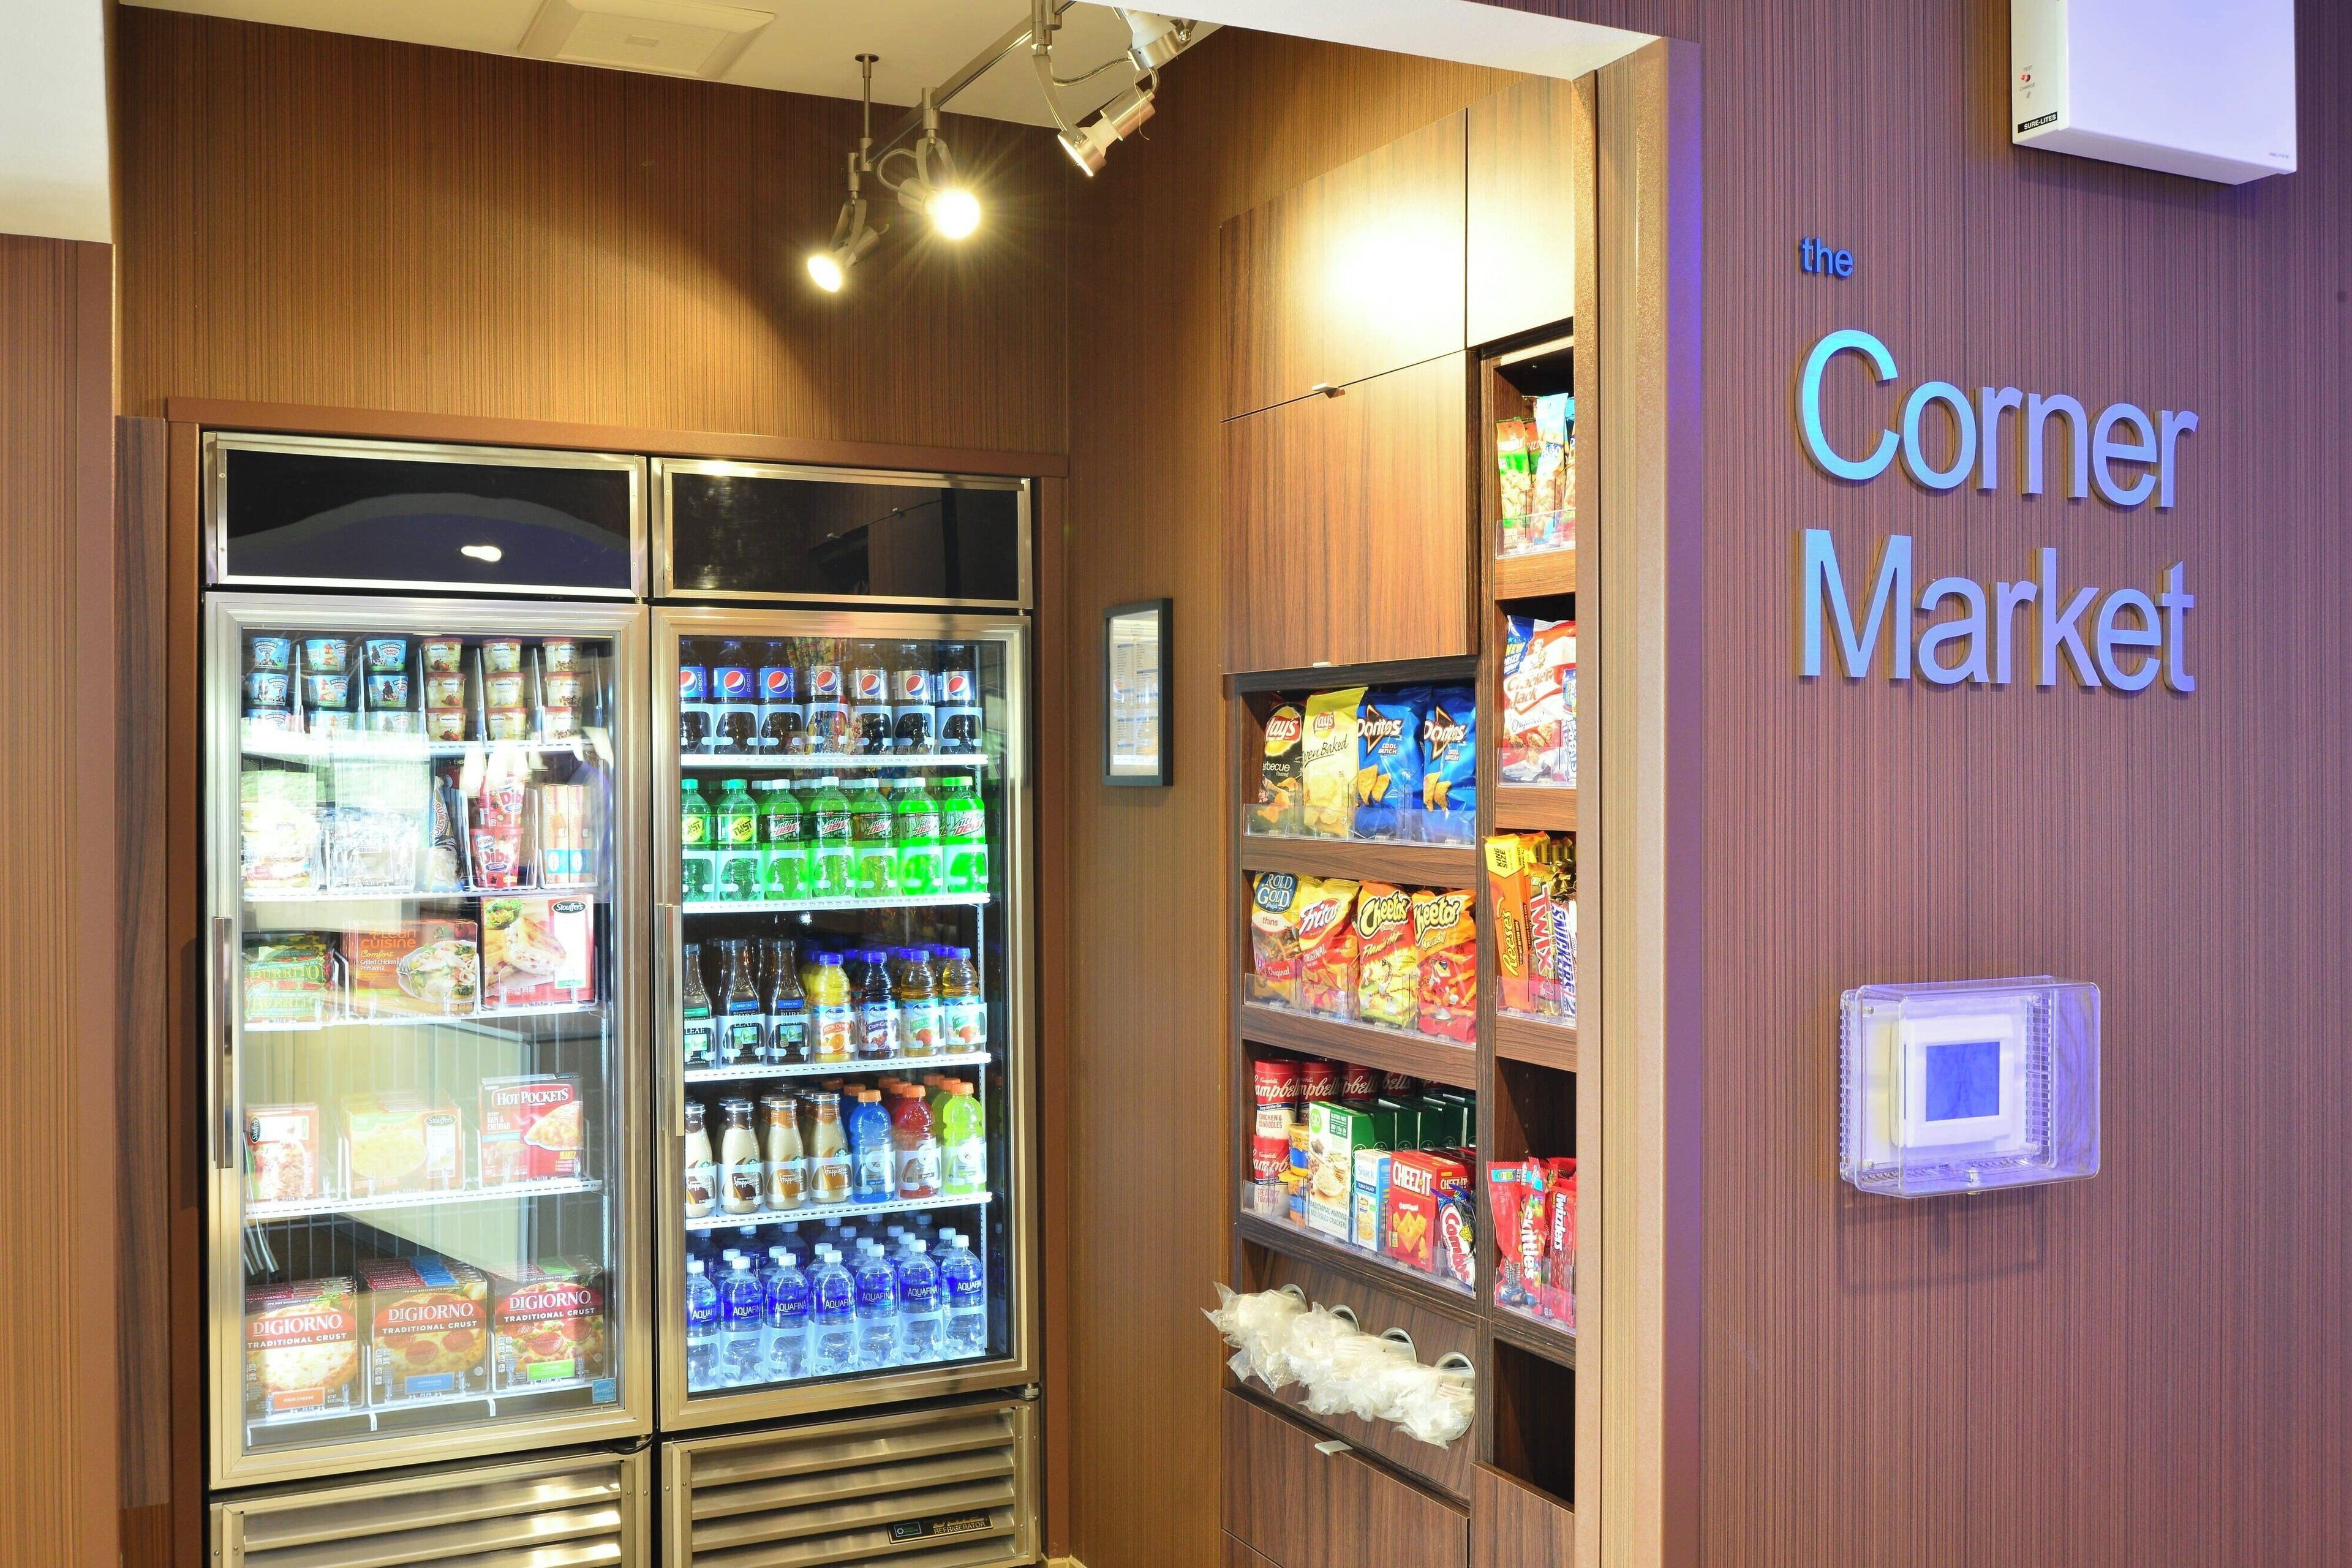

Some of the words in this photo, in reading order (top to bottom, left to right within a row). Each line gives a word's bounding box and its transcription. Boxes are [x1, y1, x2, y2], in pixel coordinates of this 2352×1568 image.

[2019, 82, 2035, 92] CHARGE
[2024, 113, 2057, 130] SURE-LITES
[1800, 237, 1854, 278] the
[1795, 328, 2199, 510] Corner
[1798, 528, 2197, 694] Market
[1510, 688, 1537, 710] Jack
[1314, 712, 1335, 729] Lay's
[1357, 718, 1403, 737] Doritos
[1266, 717, 1298, 742] Lay's
[1424, 721, 1468, 742] Doritos
[1321, 734, 1350, 756] Baked
[1262, 761, 1290, 772] arbecue
[431, 799, 447, 839] DRUMSTIC
[1494, 848, 1502, 867] KING
[1265, 873, 1291, 888] ROLD
[1257, 887, 1290, 907] GOLD
[556, 902, 584, 913] Stouffer's
[1359, 890, 1411, 939] Cheetos
[1262, 916, 1278, 927] thins
[1300, 900, 1341, 936] Fritos
[1414, 896, 1461, 945] heetos
[381, 929, 417, 939] Lean
[1530, 883, 1553, 974] TWIX
[361, 938, 417, 949] cuisine
[1502, 908, 1519, 977] Reese's
[360, 949, 394, 958] Comfort
[1303, 944, 1327, 962] ORIGINAL
[1268, 966, 1290, 979] Original
[868, 1021, 888, 1031] Cran-Gra
[497, 1091, 519, 1106] HOT
[520, 1087, 569, 1104] POCKETS
[1358, 1165, 1374, 1180] Snack
[1392, 1160, 1433, 1197] CHEEZ-IT
[1555, 1192, 1568, 1252] Twizzlers
[1444, 1212, 1471, 1283] Combos
[907, 1285, 938, 1298] AQUAFINA
[775, 1301, 807, 1313] AQUAFINA
[825, 1297, 854, 1310] AQUAFINA
[503, 1311, 564, 1322] TRADITIONAL
[567, 1308, 595, 1316] CRUST
[692, 1308, 715, 1321] AQUAF
[382, 1324, 444, 1334] TRADITIONAL
[247, 1336, 313, 1349] TRADITIONAL
[316, 1332, 347, 1341] CRUST
[934, 1521, 986, 1534] REFRIGERATOR
